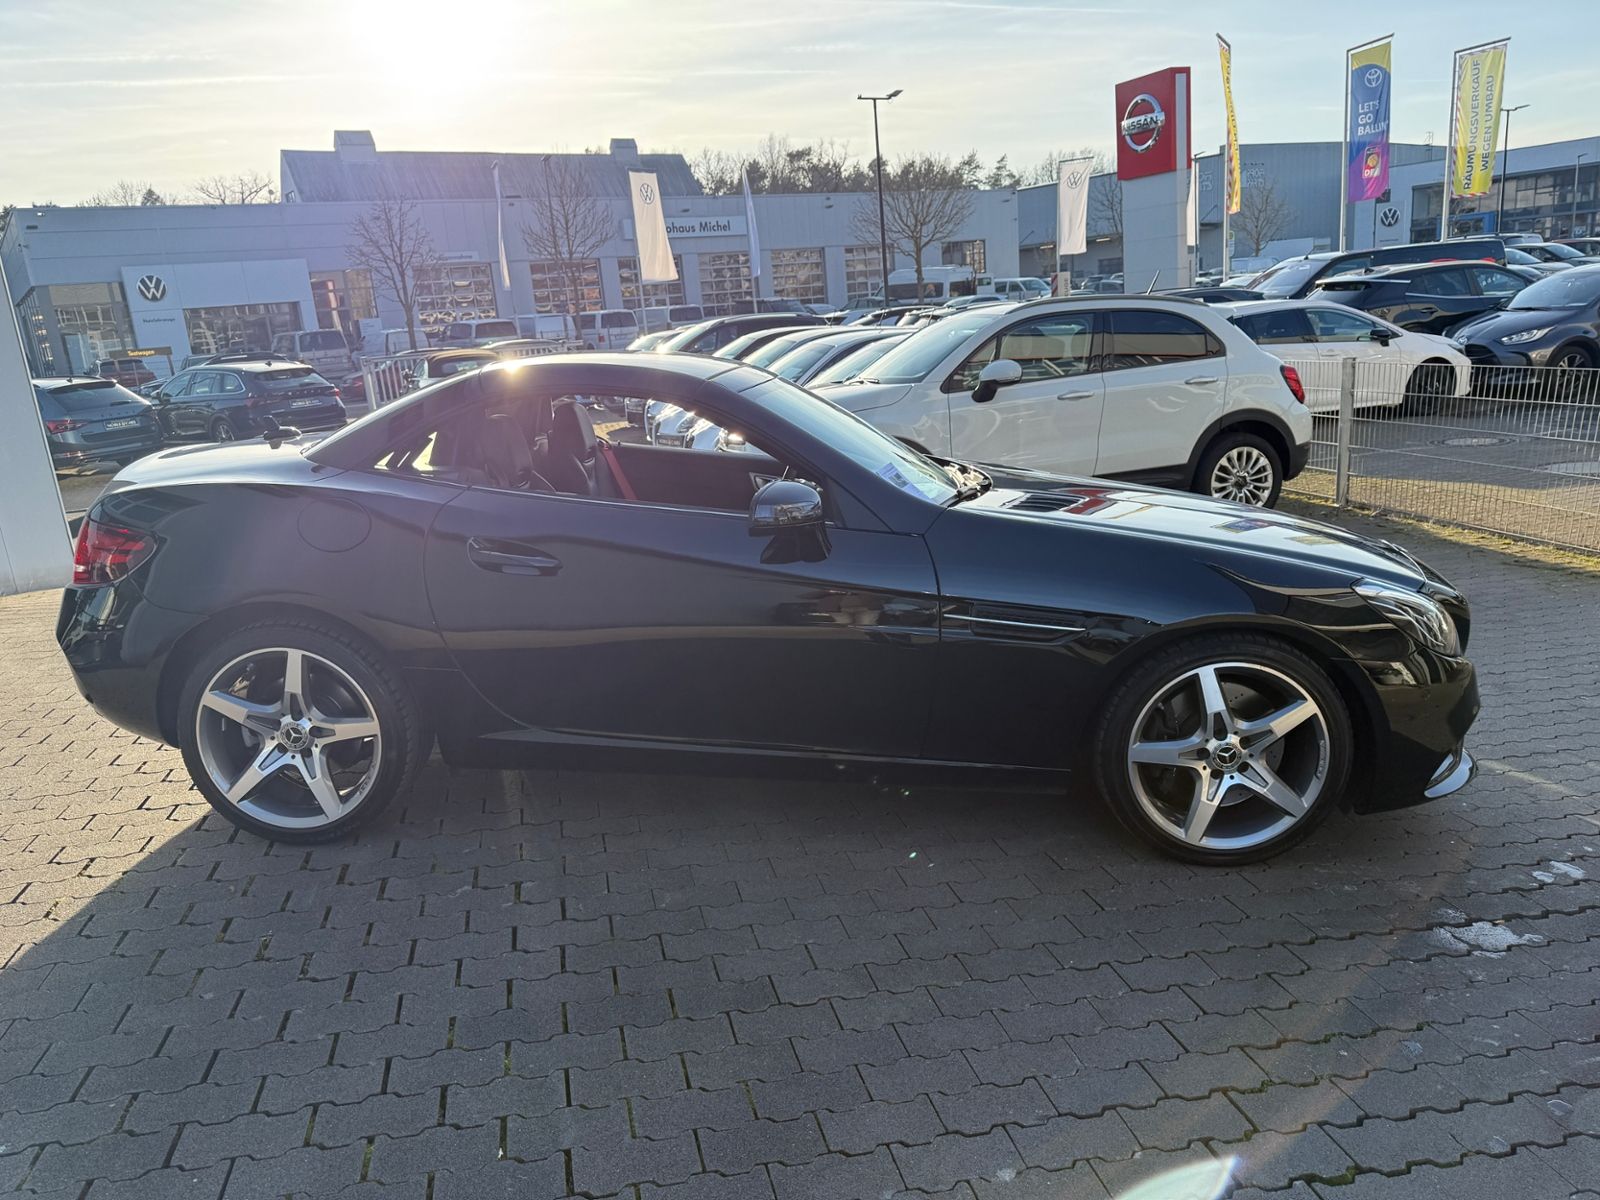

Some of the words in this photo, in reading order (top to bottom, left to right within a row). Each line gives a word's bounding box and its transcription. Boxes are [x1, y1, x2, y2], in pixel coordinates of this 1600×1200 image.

[1359, 100, 1380, 113] LET'S
[1485, 75, 1494, 122] UMBAU
[1122, 115, 1159, 134] NISSAN
[1358, 113, 1374, 125] GO
[1463, 60, 1481, 190] RÄUMUNGSVERKAUF
[1480, 126, 1492, 172] WEGEN
[666, 222, 696, 234] ohaus
[699, 220, 731, 232] Michel
